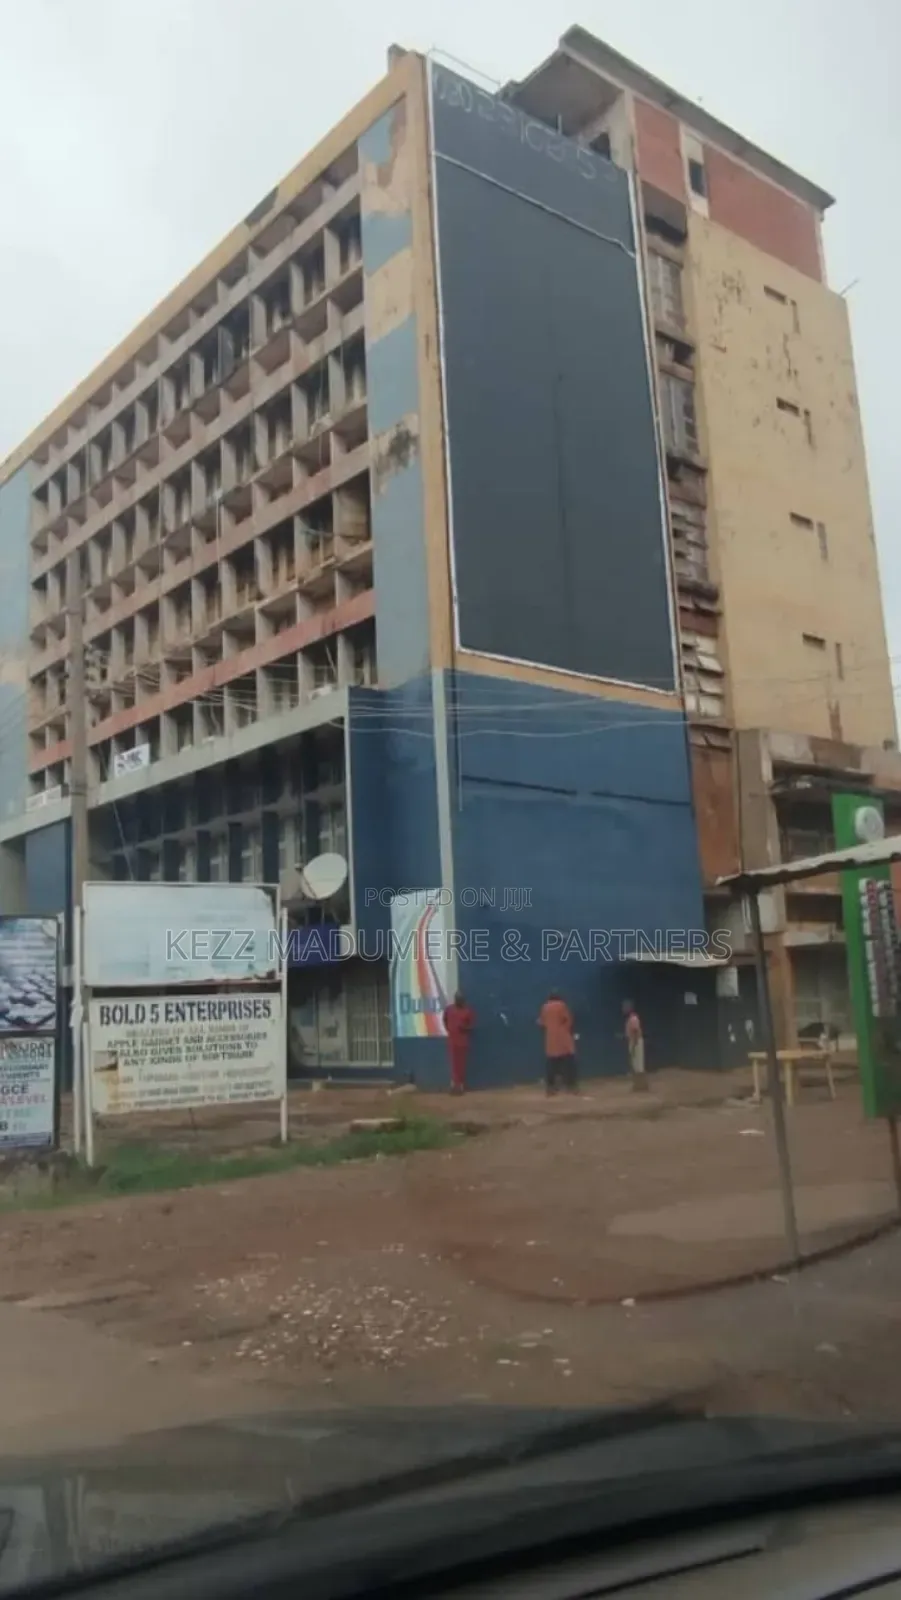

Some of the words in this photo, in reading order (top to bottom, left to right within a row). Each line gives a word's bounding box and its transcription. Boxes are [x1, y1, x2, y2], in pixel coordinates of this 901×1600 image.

[100, 1003, 146, 1026] BOLD
[150, 1003, 159, 1024] 5
[165, 999, 271, 1024] ENTERPRISES
